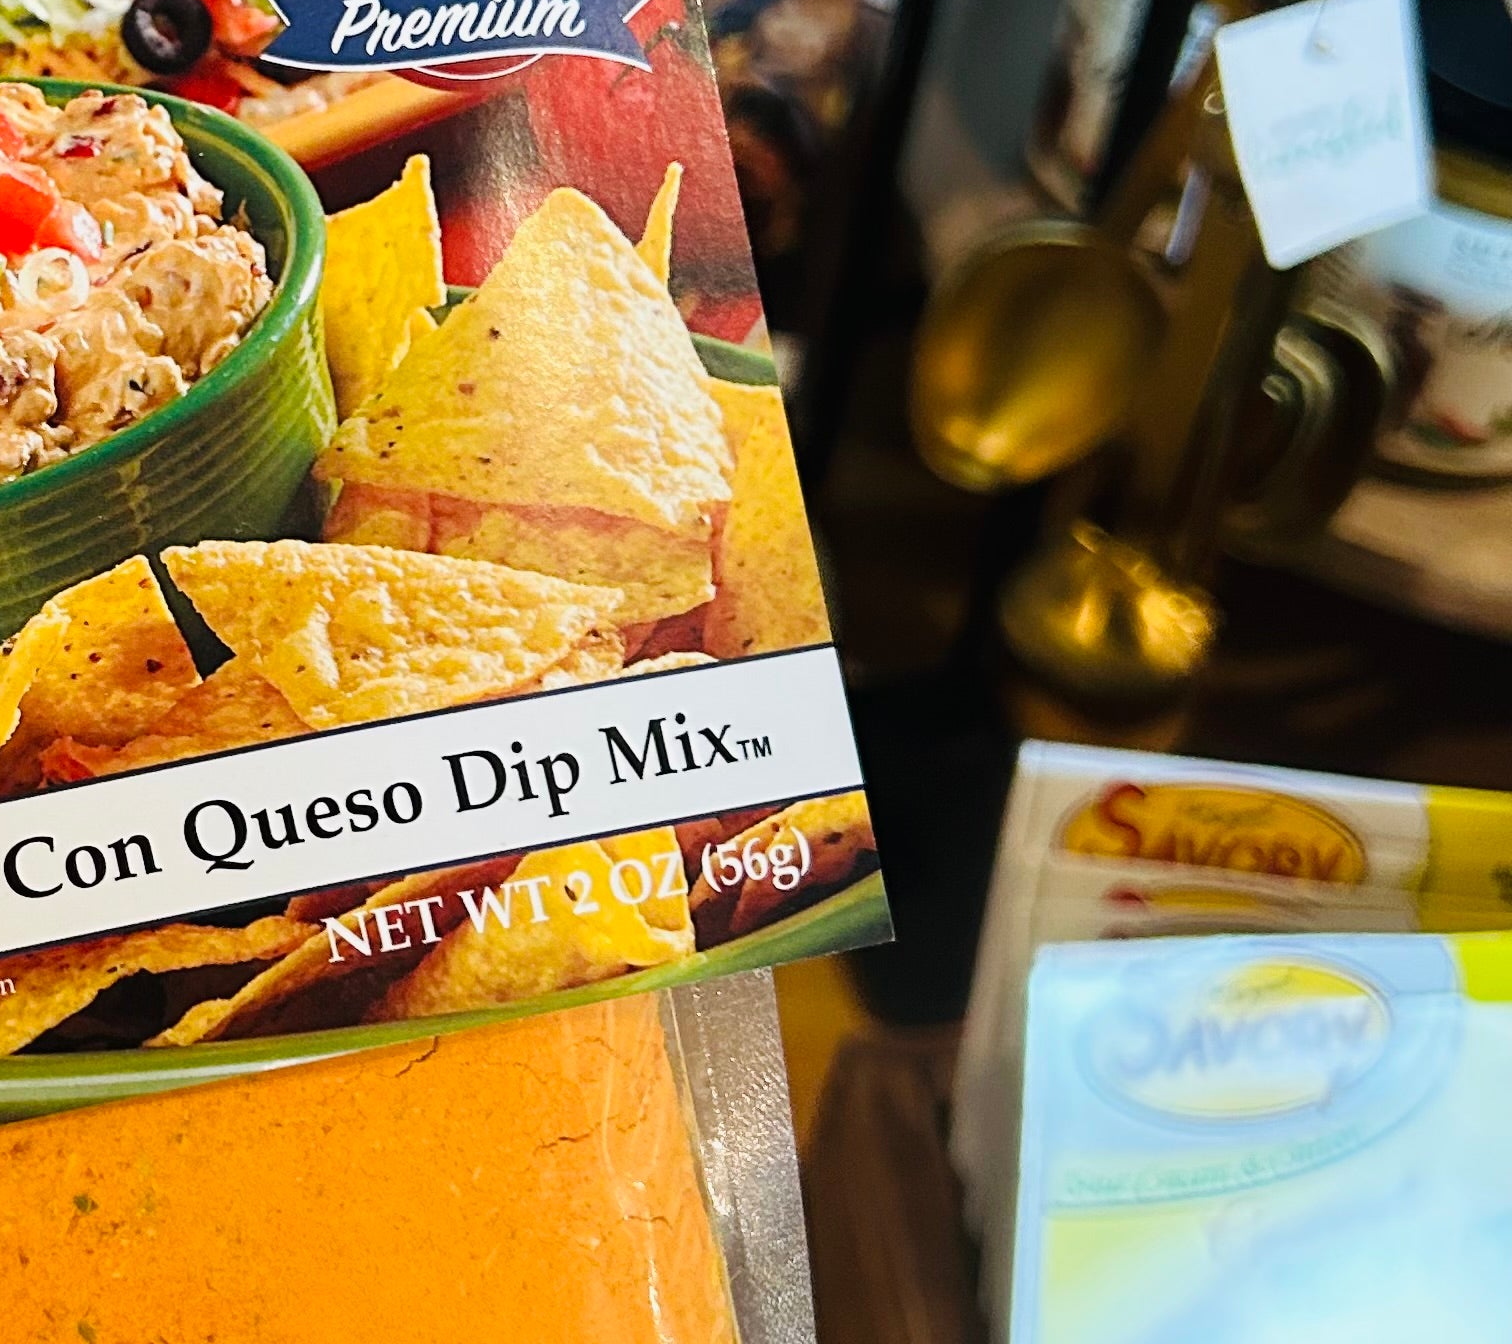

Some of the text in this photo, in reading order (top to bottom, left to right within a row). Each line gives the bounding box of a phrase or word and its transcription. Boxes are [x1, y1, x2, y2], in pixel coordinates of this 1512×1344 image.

[3, 828, 163, 900] Con
[183, 781, 423, 876] Queso
[442, 740, 580, 818] Dip
[324, 826, 811, 964] NET WT 2 OZ (56g)
